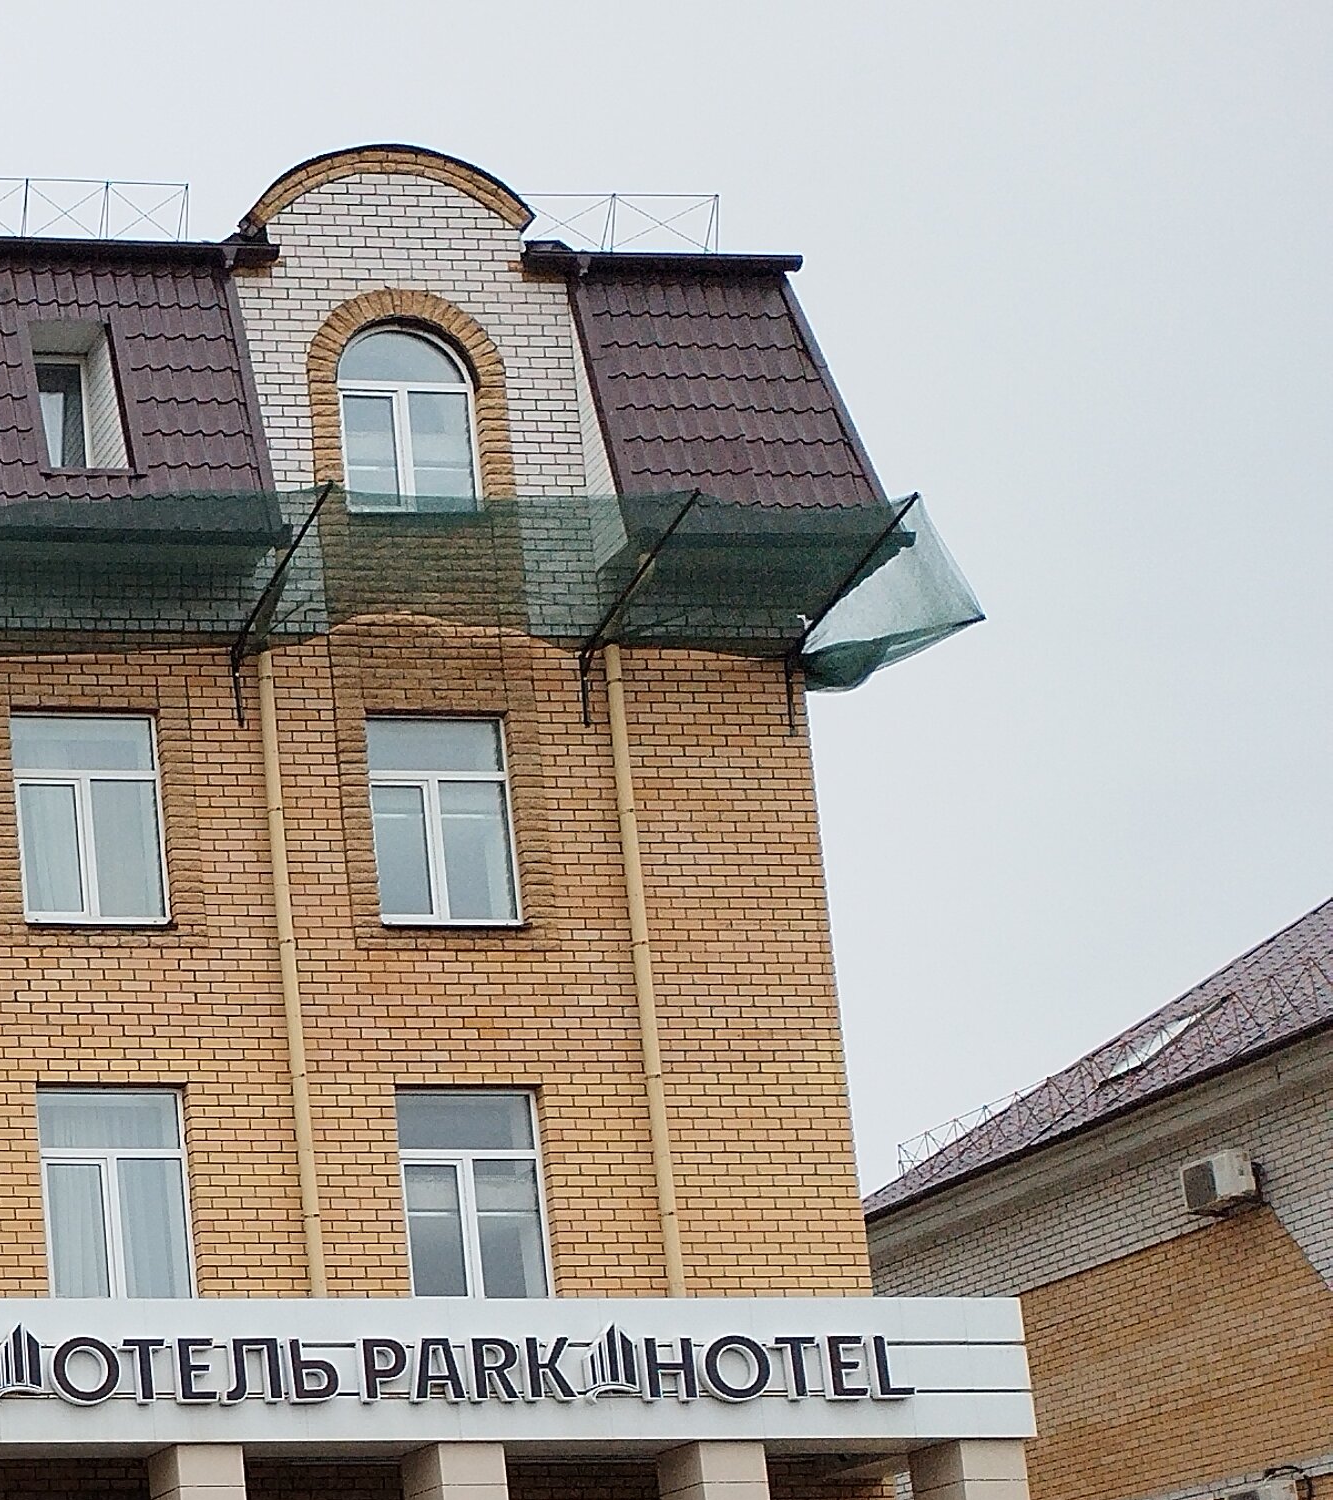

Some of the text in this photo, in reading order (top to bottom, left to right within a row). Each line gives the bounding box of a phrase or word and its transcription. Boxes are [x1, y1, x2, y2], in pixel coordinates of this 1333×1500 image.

[49, 1335, 341, 1406] ОТЕЛЬ
[356, 1333, 917, 1404] PARK HOTEL
